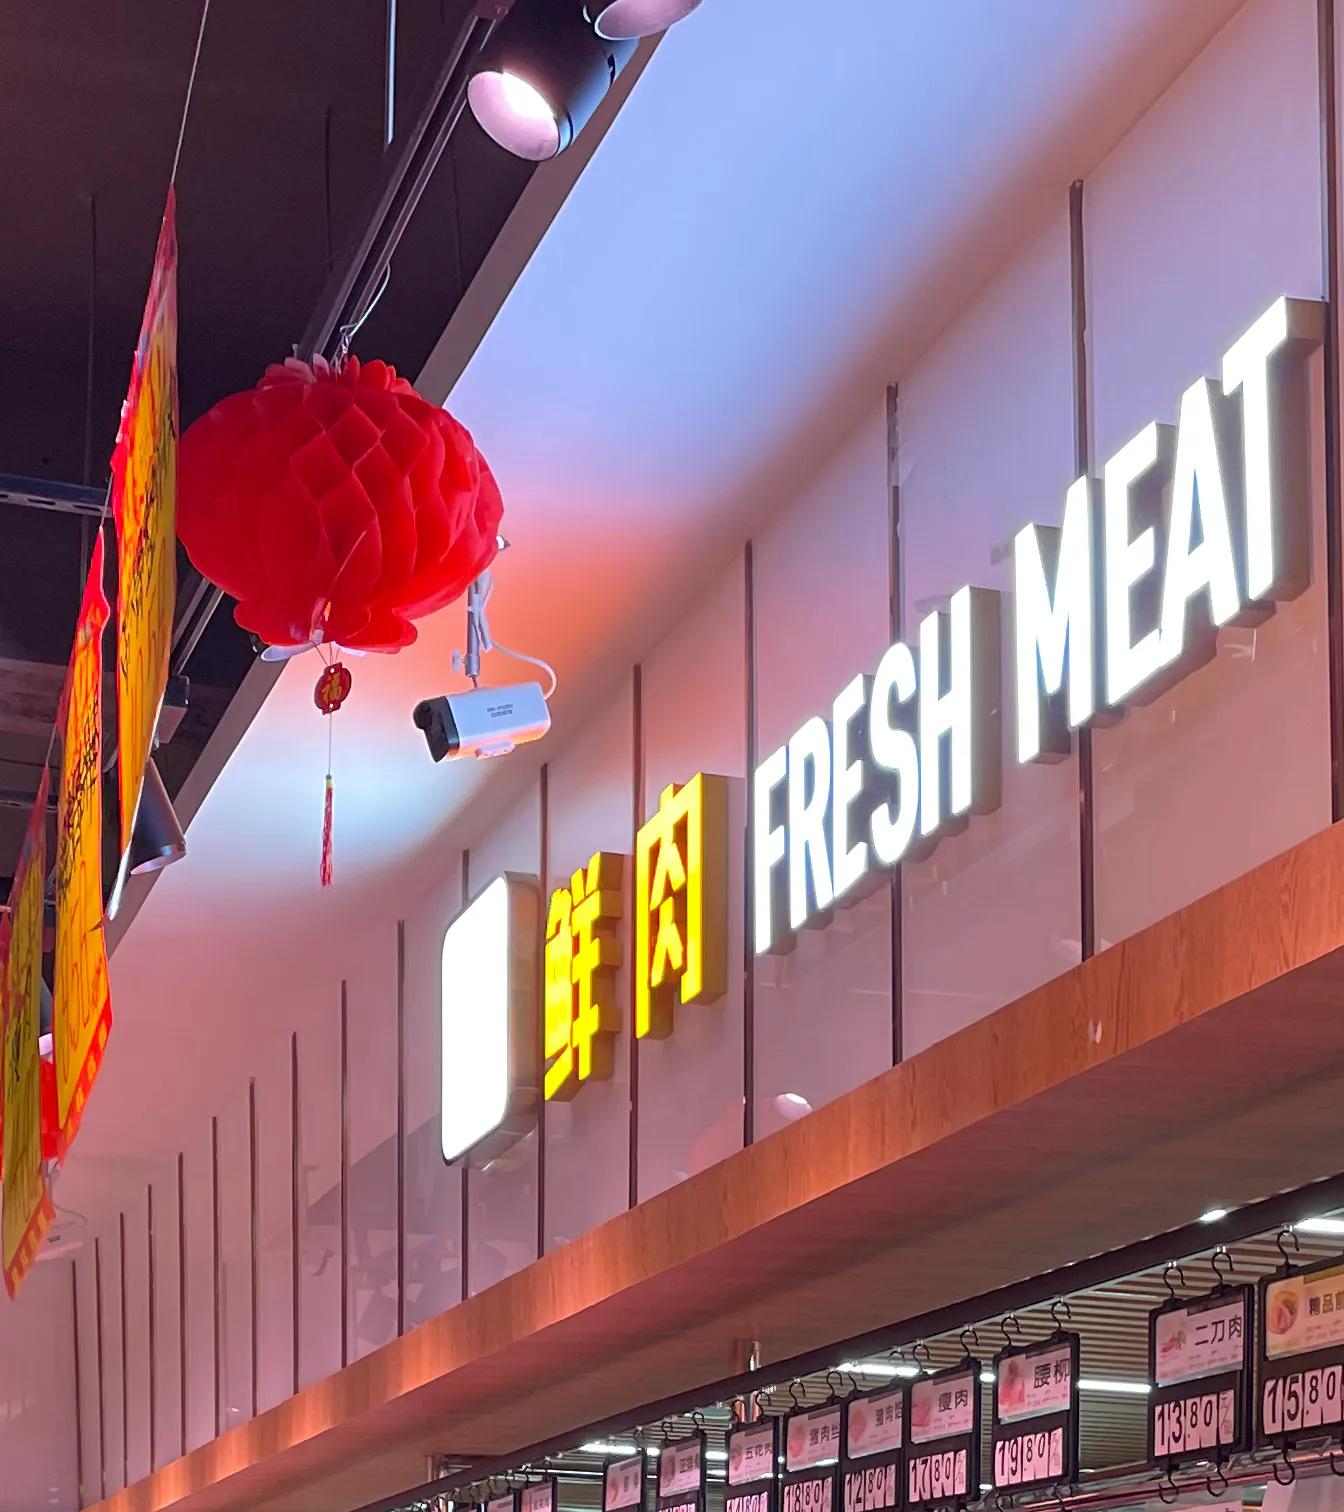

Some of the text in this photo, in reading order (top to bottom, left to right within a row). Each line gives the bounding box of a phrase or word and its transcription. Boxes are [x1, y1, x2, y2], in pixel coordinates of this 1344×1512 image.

[752, 294, 1290, 956] FRESH MEAT
[544, 770, 706, 1101] 鲜肉
[1194, 1313, 1243, 1347] 二刀肉
[1033, 1357, 1071, 1390] 腰柳
[938, 1388, 969, 1413] 瘦肉
[1267, 1369, 1338, 1425] 15.80
[1157, 1395, 1214, 1447] 13.80
[910, 1456, 952, 1496] 17.80
[998, 1432, 1047, 1477] 19.80
